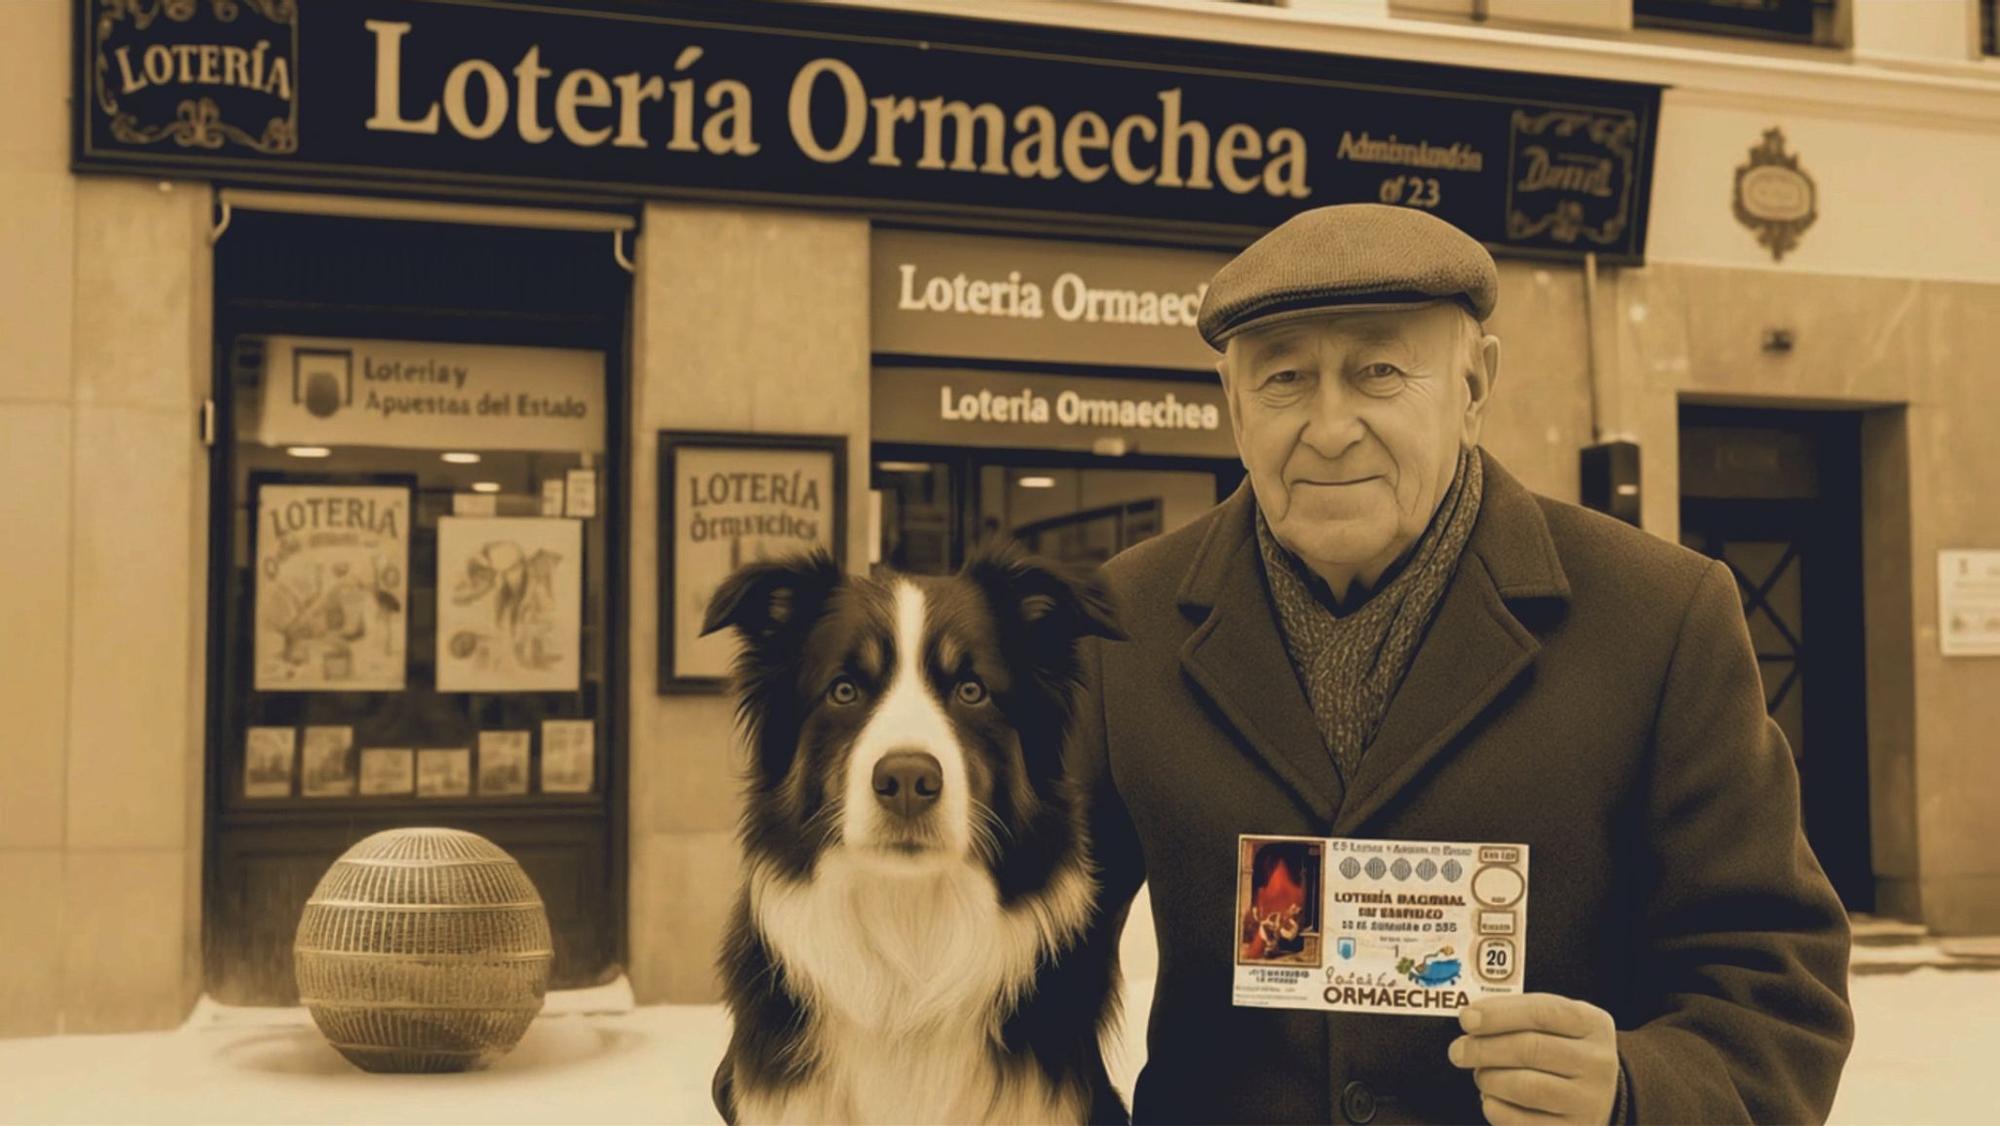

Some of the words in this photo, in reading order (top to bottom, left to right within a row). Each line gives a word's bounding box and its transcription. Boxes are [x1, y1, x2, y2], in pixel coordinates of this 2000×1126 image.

[116, 41, 291, 99] LOTERÍA
[366, 19, 760, 155] Lotería
[788, 57, 1311, 197] Ormaechea
[1407, 177, 1441, 207] 23
[899, 264, 1043, 318] Loteria
[476, 394, 510, 416] del
[1057, 390, 1219, 429] Ormaechea
[1486, 949, 1507, 967] 20
[1323, 986, 1470, 1009] ORMAECHEA
